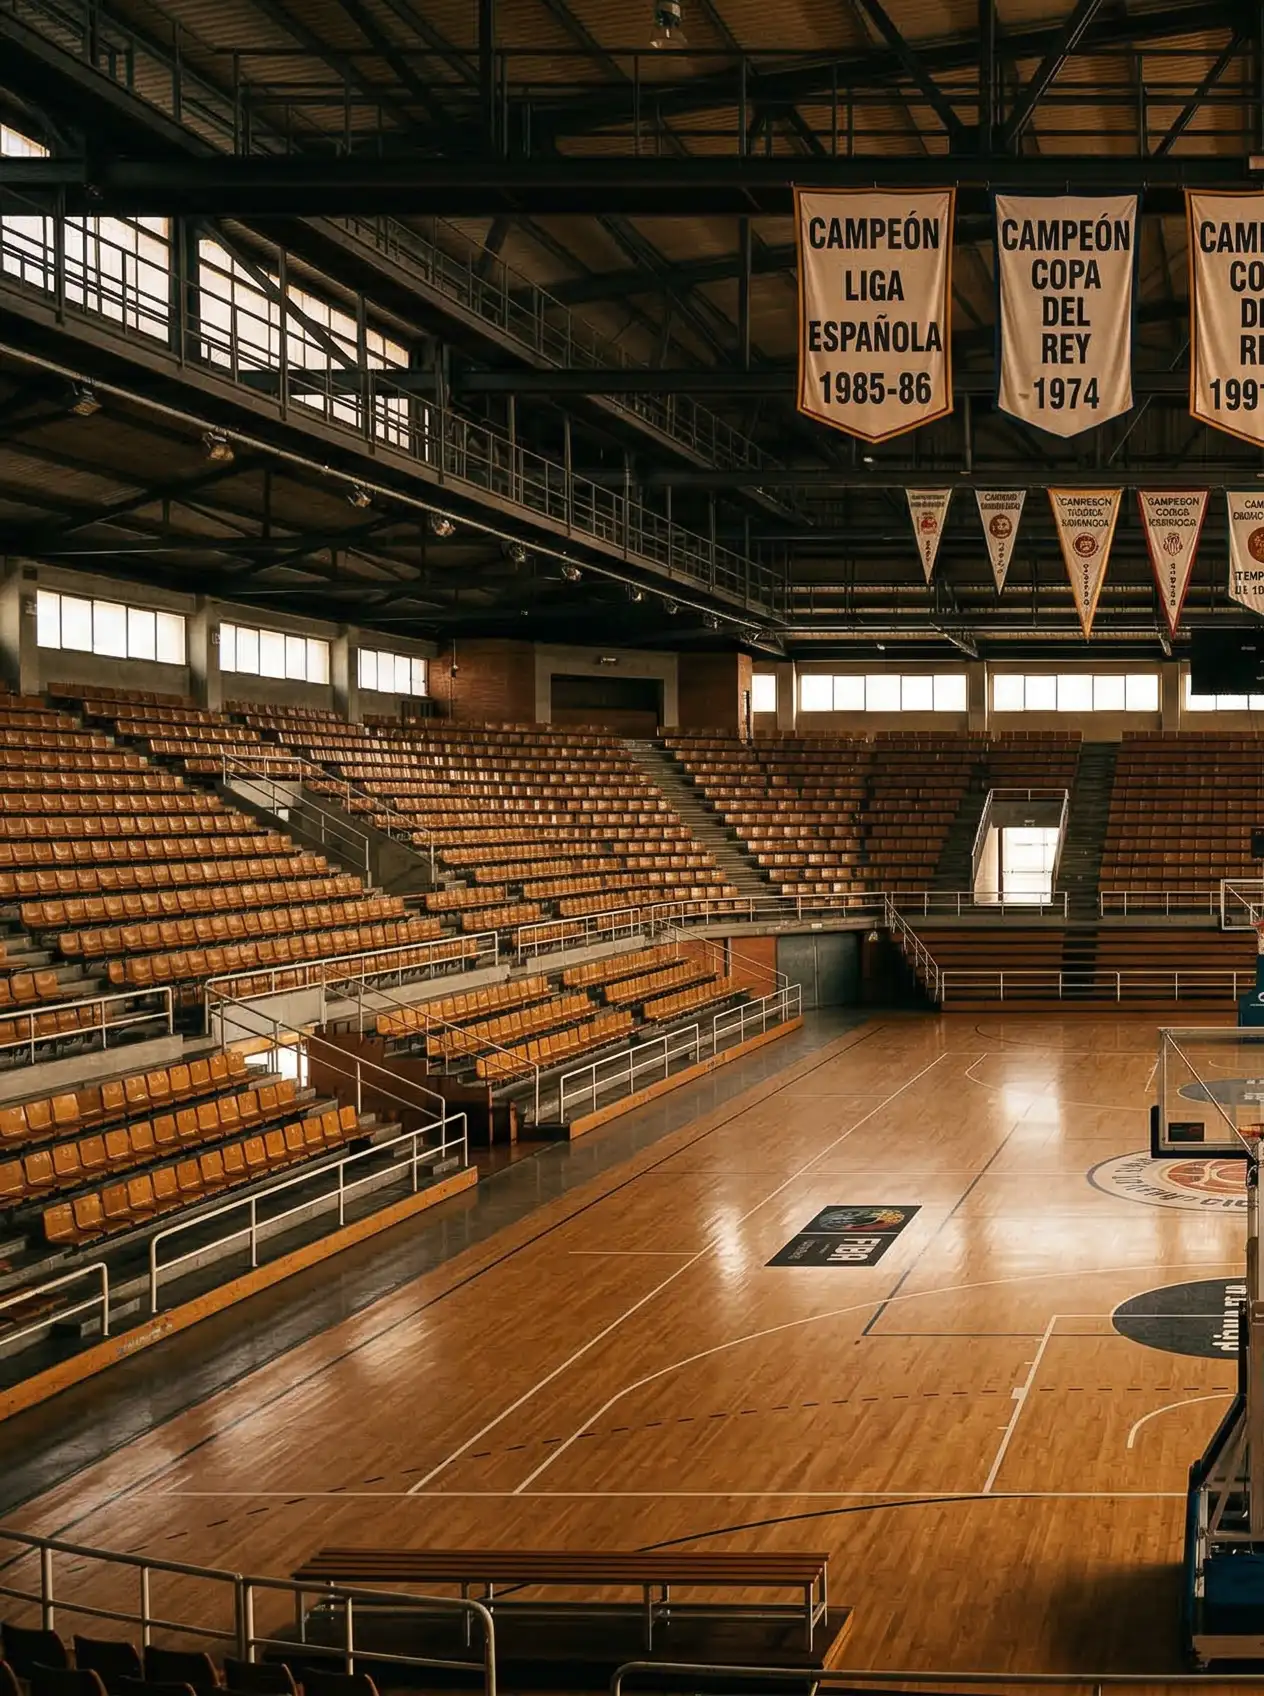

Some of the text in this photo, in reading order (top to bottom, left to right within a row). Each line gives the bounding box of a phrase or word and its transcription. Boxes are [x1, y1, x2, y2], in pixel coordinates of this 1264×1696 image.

[809, 211, 940, 250] CAMPEÓN
[1001, 213, 1130, 251] CAMPEÓN
[845, 270, 905, 301] LIGA
[1031, 259, 1102, 290] COPA
[1042, 296, 1091, 327] DEL
[808, 314, 943, 352] ESPAÑOLA
[1041, 333, 1092, 364] REY
[819, 371, 932, 405] 1985-86
[1033, 377, 1100, 410] 1974
[826, 1238, 882, 1261] FIBA
